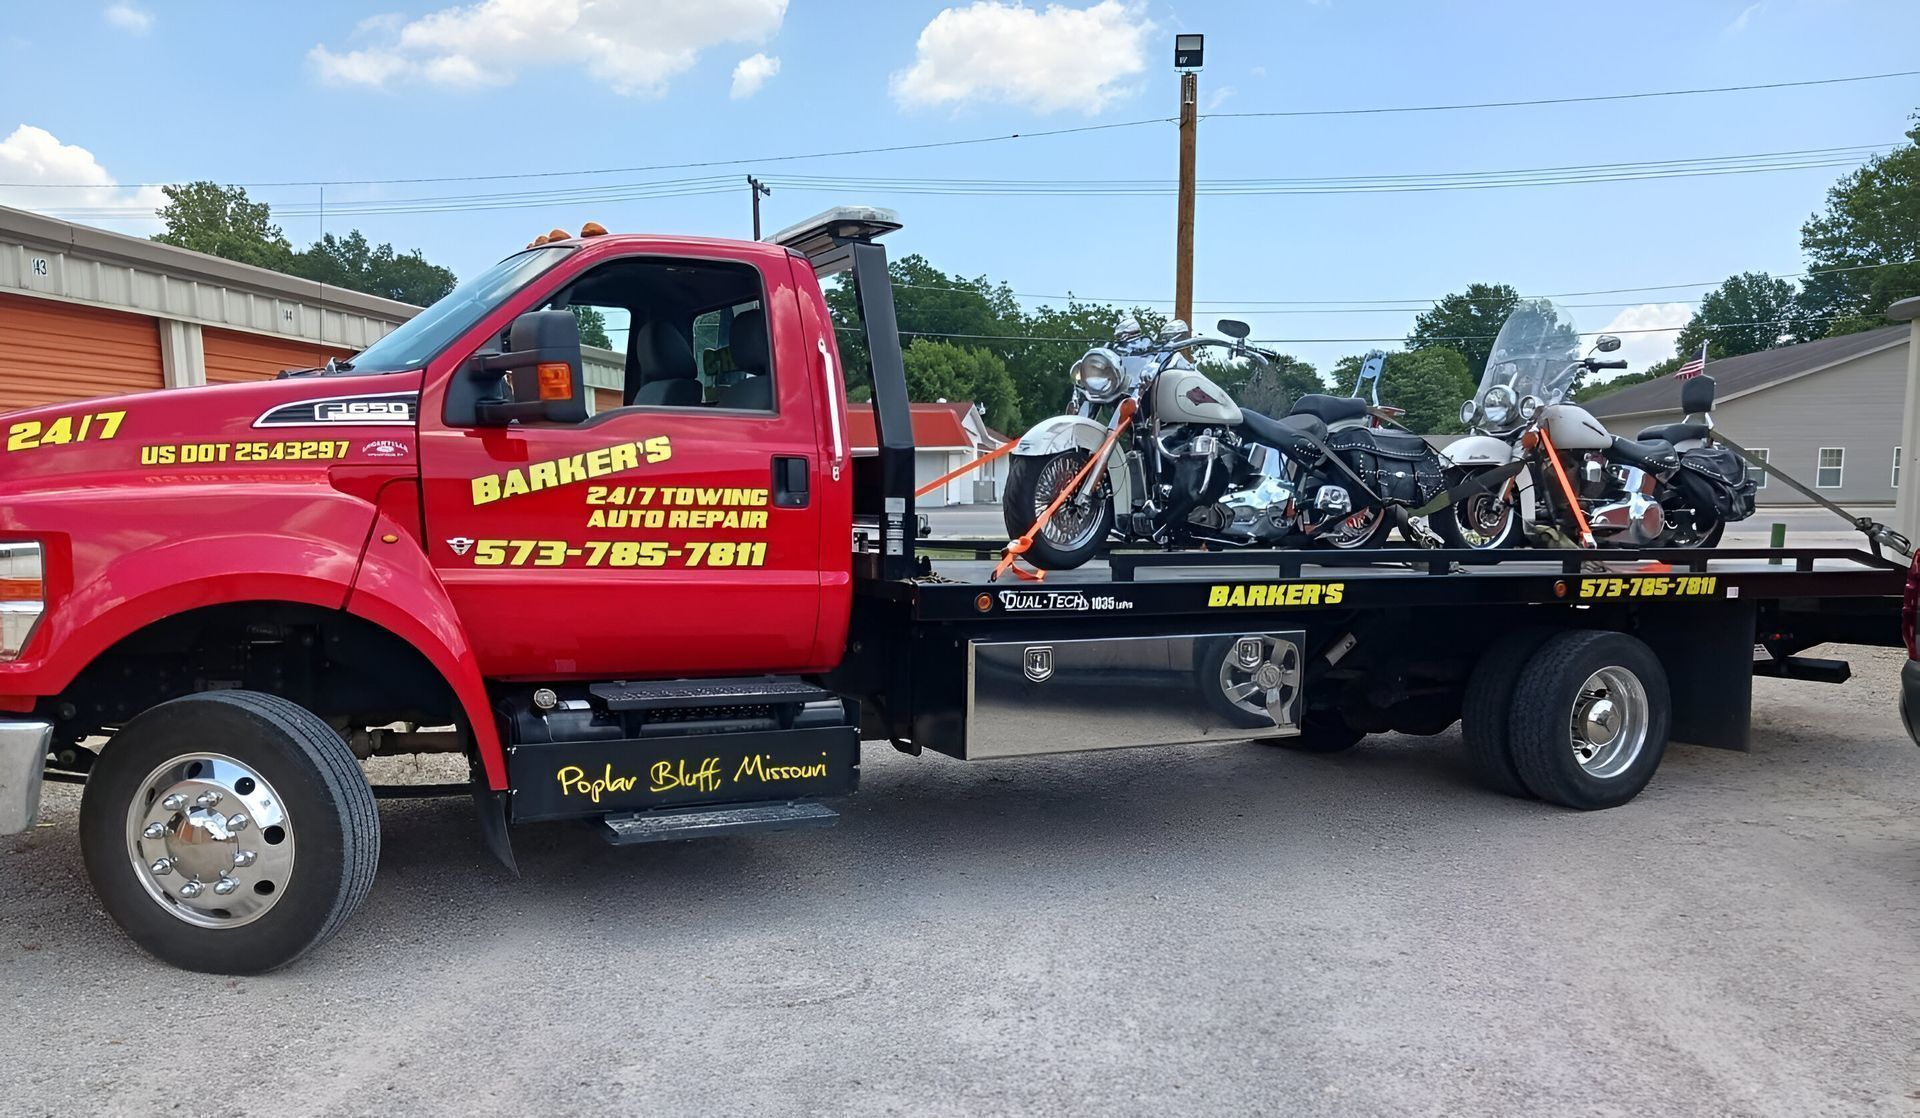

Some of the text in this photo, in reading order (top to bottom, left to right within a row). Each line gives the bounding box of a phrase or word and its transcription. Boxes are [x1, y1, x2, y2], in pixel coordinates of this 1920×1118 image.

[7, 411, 127, 452] 24/7
[141, 445, 176, 465] US
[181, 442, 231, 463] DOT
[235, 440, 350, 462] 2543297
[472, 435, 672, 506] BARKER'S
[586, 486, 768, 507] 24/7 TOWING
[587, 509, 768, 529] AUTO REPAIR
[474, 539, 768, 567] 573-785-7811
[1207, 583, 1345, 607] BARKER'S
[1579, 576, 1717, 598] 573-785-7811
[1091, 596, 1115, 610] 1035
[556, 751, 828, 803] Poplar Bluff, Missouri
